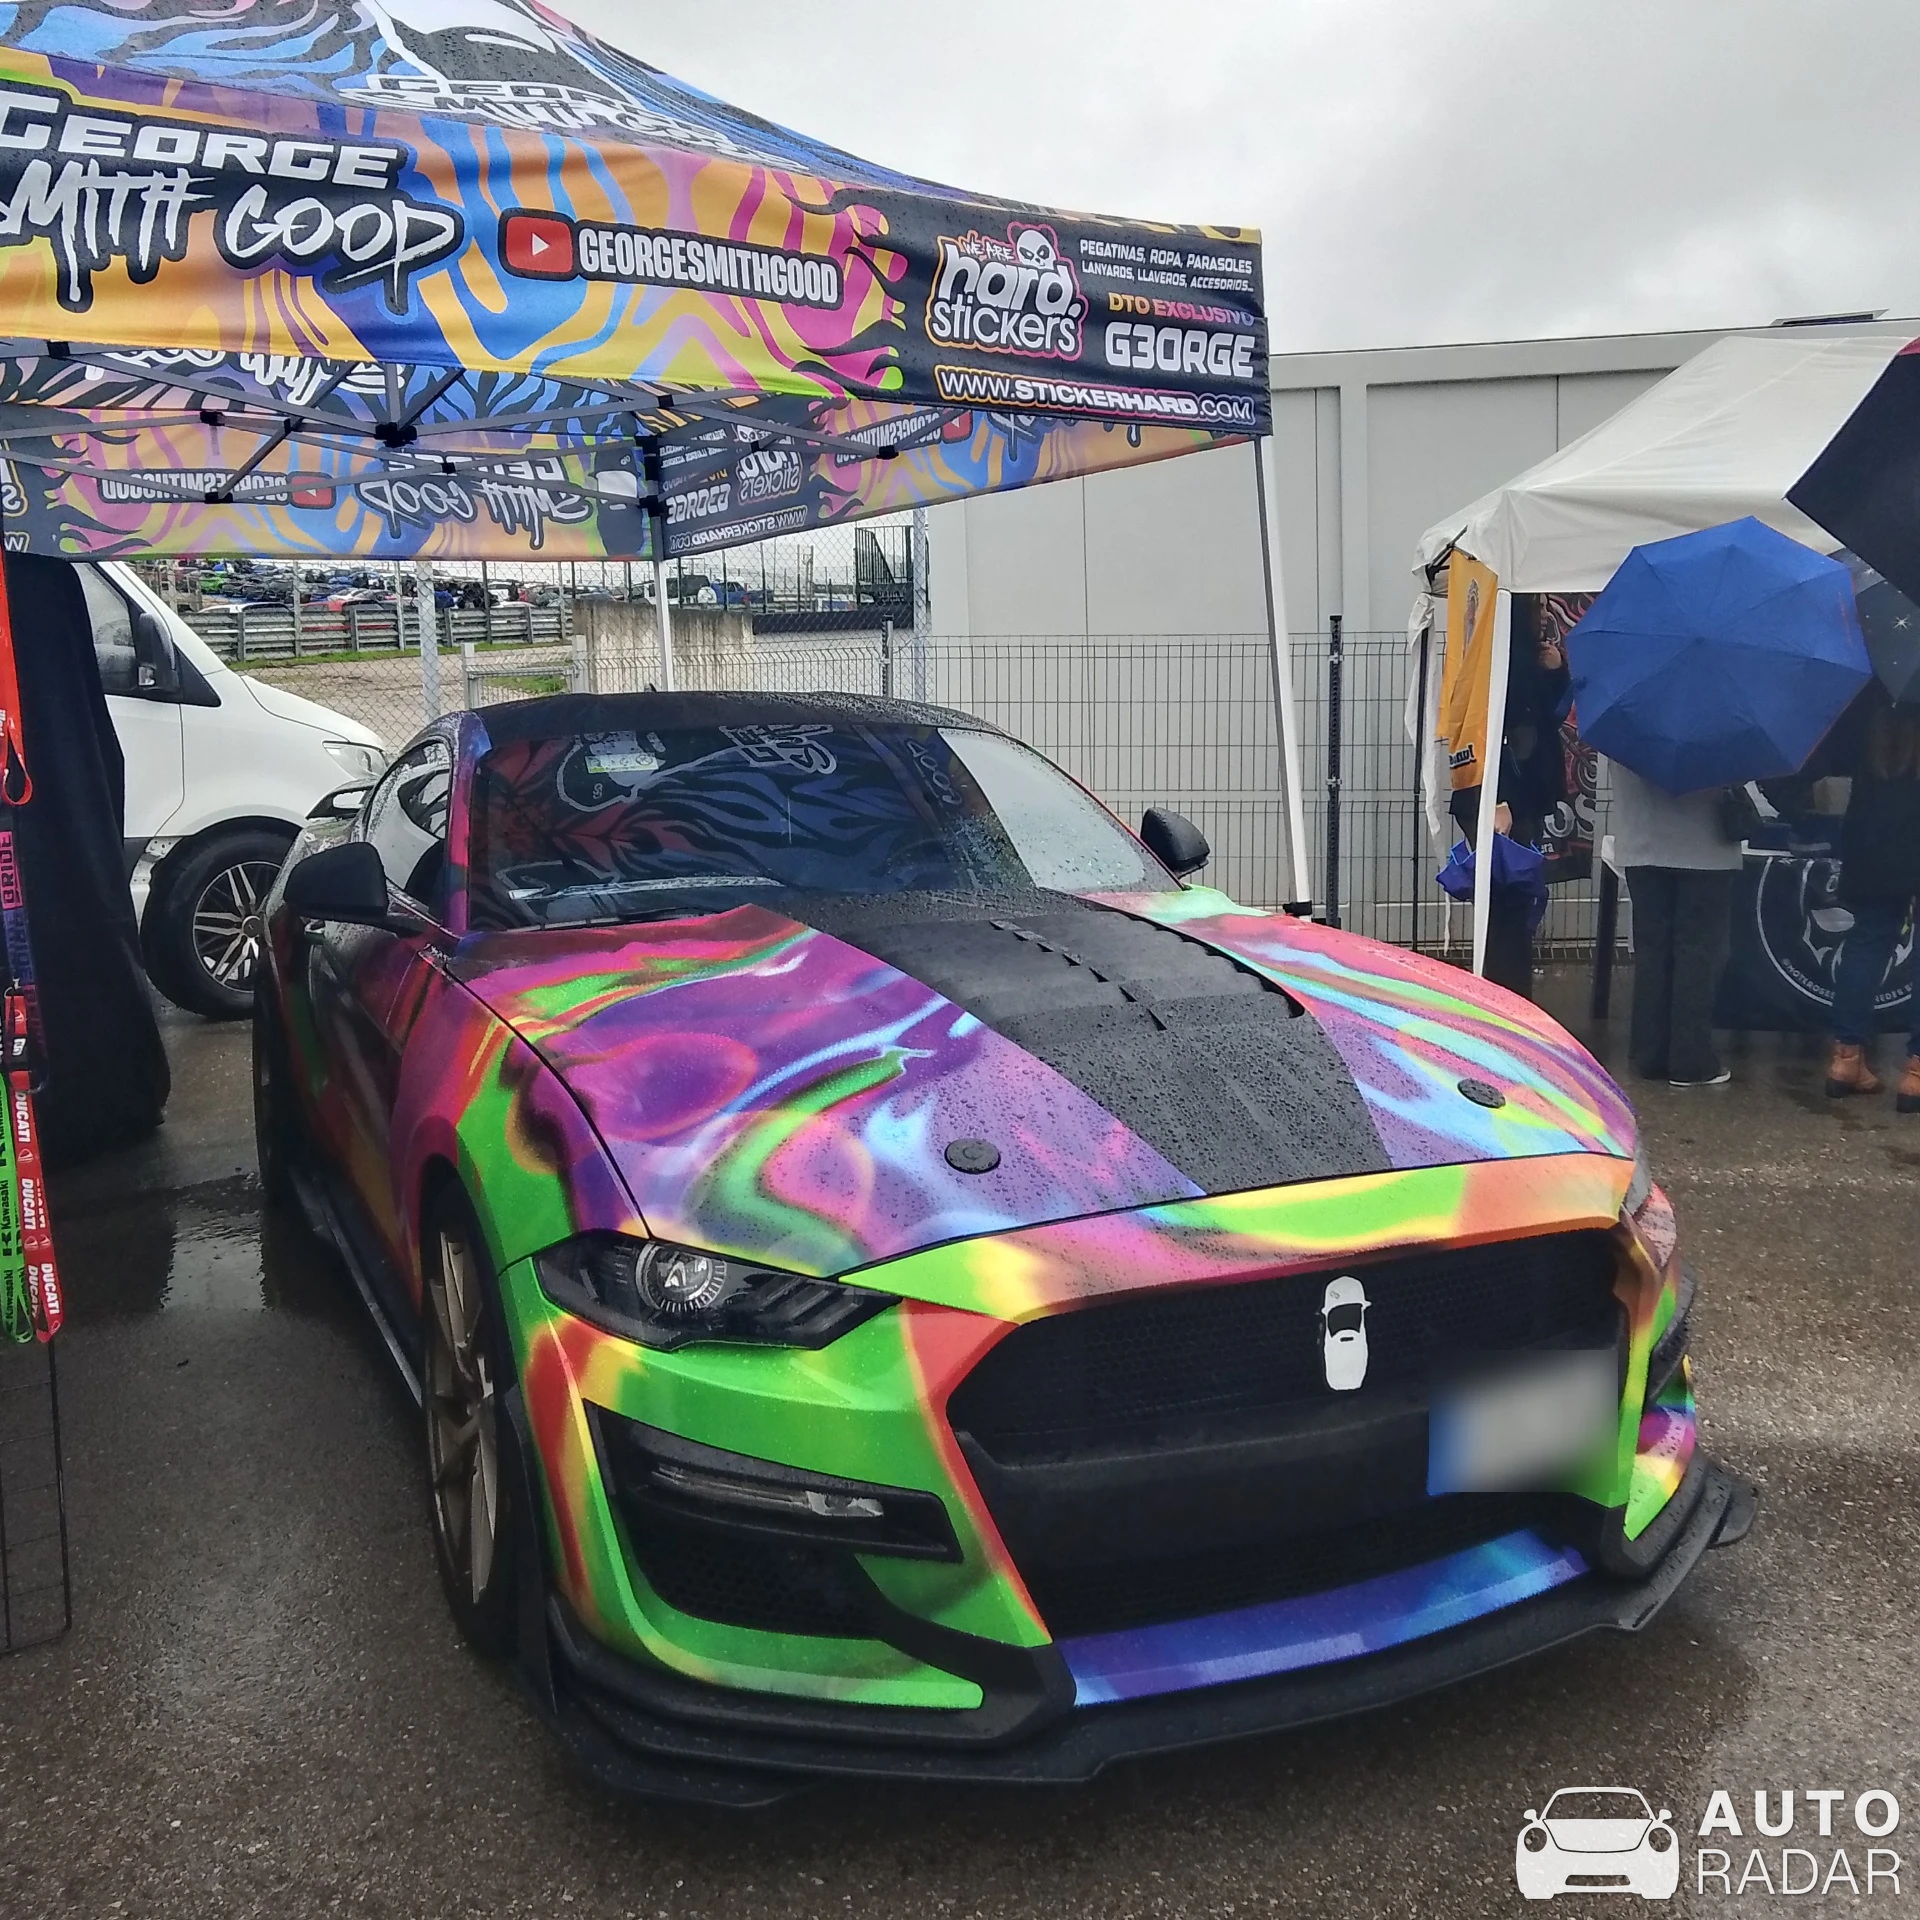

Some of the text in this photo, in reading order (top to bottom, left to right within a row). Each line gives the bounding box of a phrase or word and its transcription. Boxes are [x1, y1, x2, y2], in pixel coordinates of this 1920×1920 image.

[0, 90, 398, 189] GEORGE
[0, 159, 456, 310] MITH GOOD
[963, 237, 1014, 262] WE ARE
[1080, 238, 1147, 264] PEGATINAS,
[1186, 253, 1253, 275] PARASOLES
[578, 230, 838, 304] GEORGESMITHGOOD
[1081, 259, 1135, 282] LANYARDS,
[1137, 268, 1188, 289] LLAVEROS,
[1107, 291, 1151, 315] DTO
[940, 369, 1252, 421] WWW.STICKERHARD.COM
[15, 1090, 31, 1143] DUCATI
[0, 1179, 11, 1230] Kawasaki
[21, 1178, 37, 1231] DUCATI
[40, 1262, 60, 1315] DUCATI
